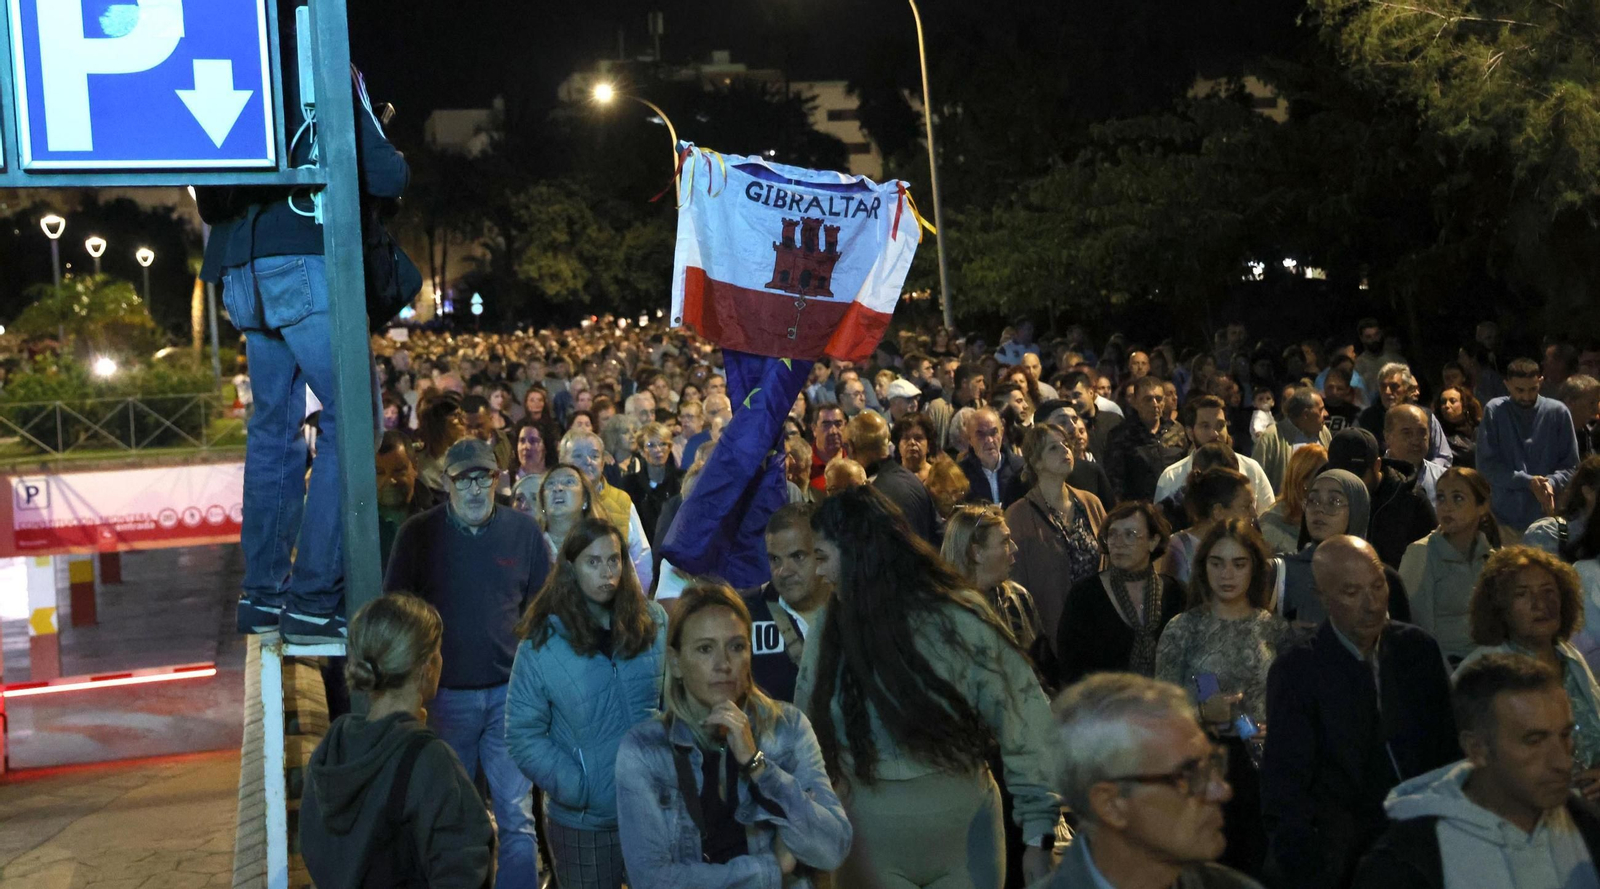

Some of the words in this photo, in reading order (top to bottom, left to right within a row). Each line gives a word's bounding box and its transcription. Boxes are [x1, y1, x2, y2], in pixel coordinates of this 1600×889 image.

[36, 0, 185, 152] P
[745, 181, 881, 220] GIBRALTAR
[25, 485, 39, 504] P
